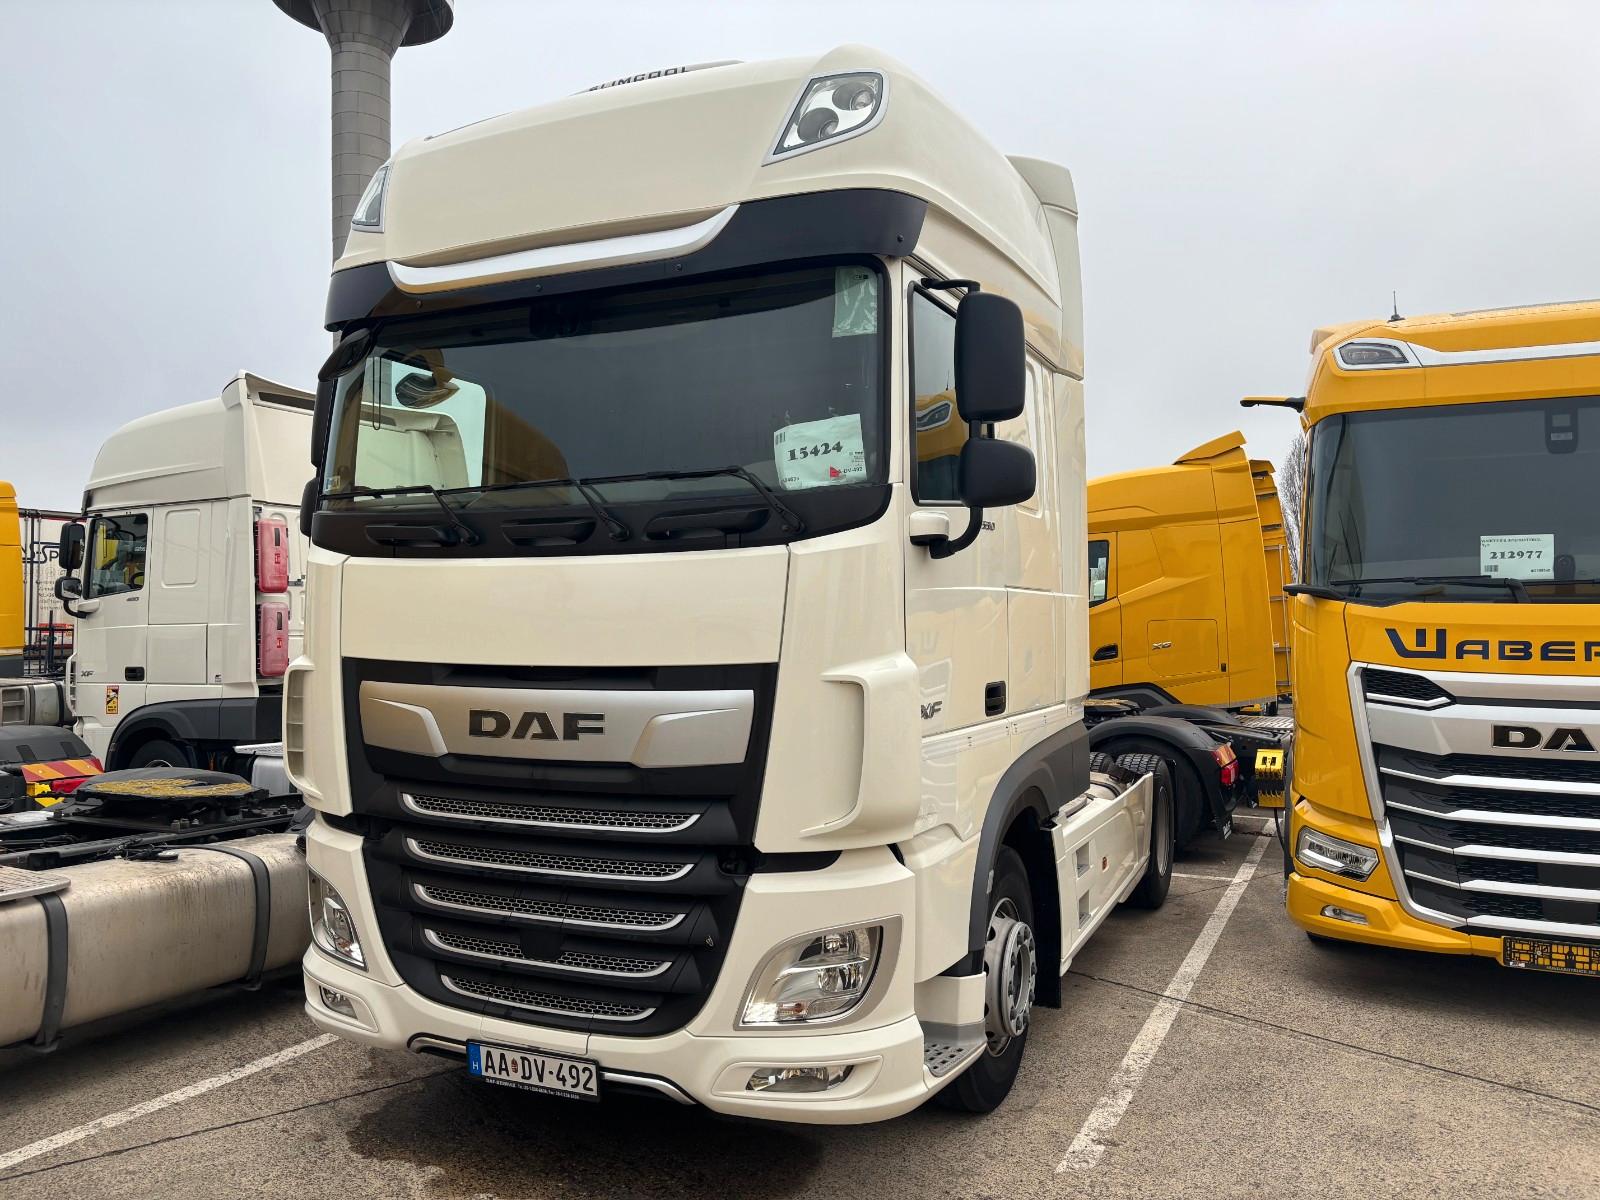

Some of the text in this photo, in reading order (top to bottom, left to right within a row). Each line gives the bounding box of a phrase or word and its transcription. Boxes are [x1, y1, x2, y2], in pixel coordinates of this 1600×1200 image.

[787, 440, 843, 461] 15424
[1489, 550, 1543, 560] 212977
[469, 709, 605, 741] DAF
[472, 1060, 479, 1071] H
